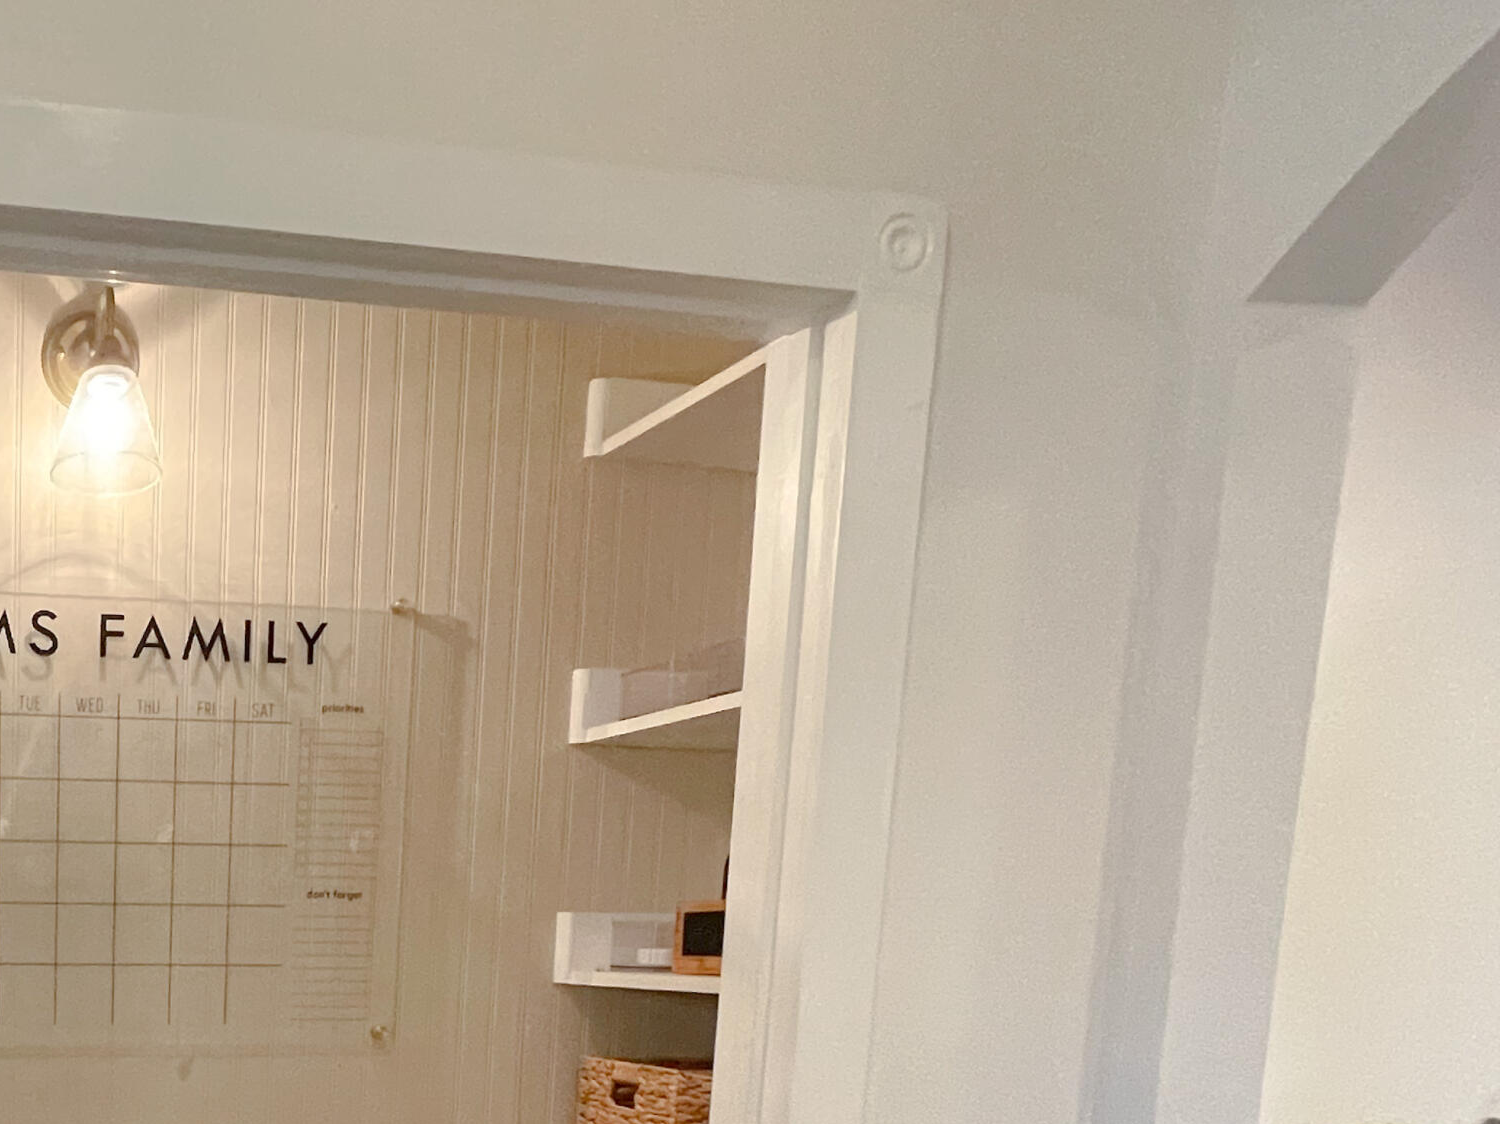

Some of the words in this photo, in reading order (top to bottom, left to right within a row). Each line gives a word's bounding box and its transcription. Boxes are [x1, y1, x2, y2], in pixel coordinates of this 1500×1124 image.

[100, 614, 328, 666] FAMILY
[19, 695, 41, 712] TUE
[76, 697, 105, 713] WED
[137, 698, 161, 714] THU
[197, 701, 217, 717] FRI
[252, 702, 275, 718] SAT
